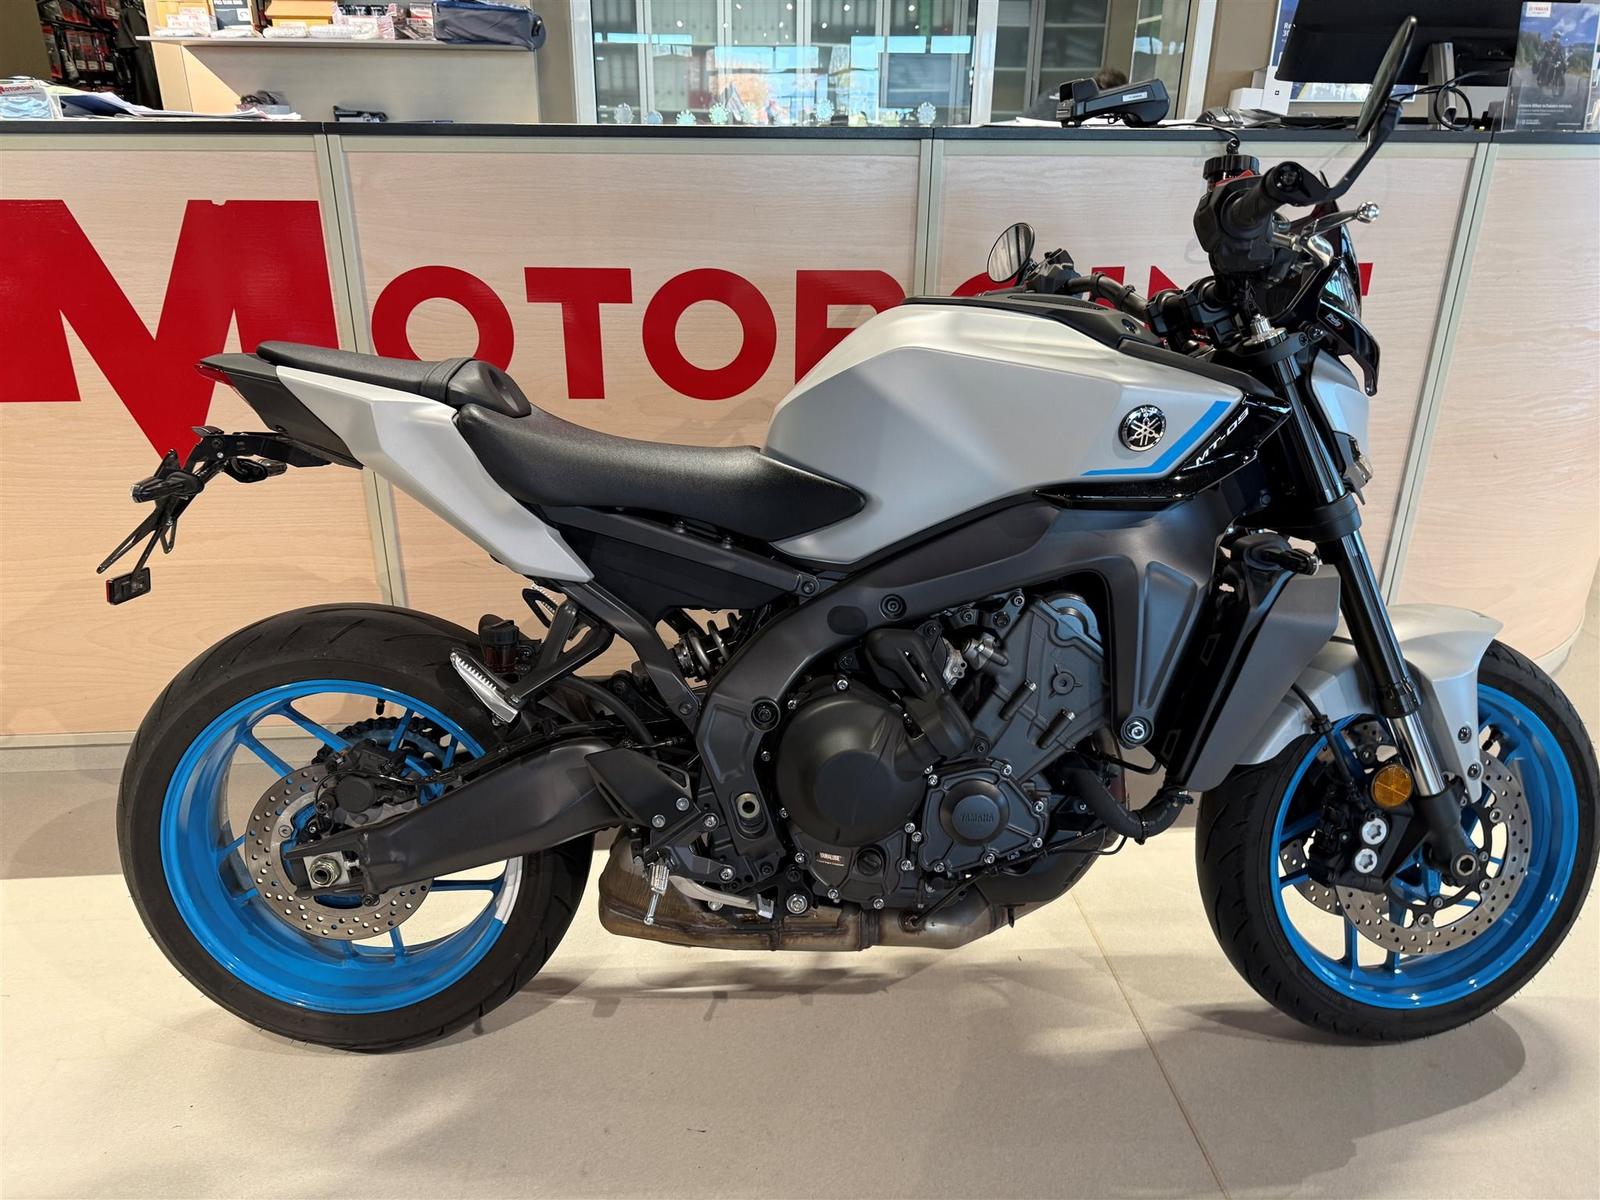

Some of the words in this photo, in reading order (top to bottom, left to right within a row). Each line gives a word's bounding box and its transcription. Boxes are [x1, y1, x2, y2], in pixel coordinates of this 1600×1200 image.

[0, 199, 1374, 469] MOTOP
[1195, 406, 1249, 466] MT-09
[960, 812, 994, 823] YAMAHA
